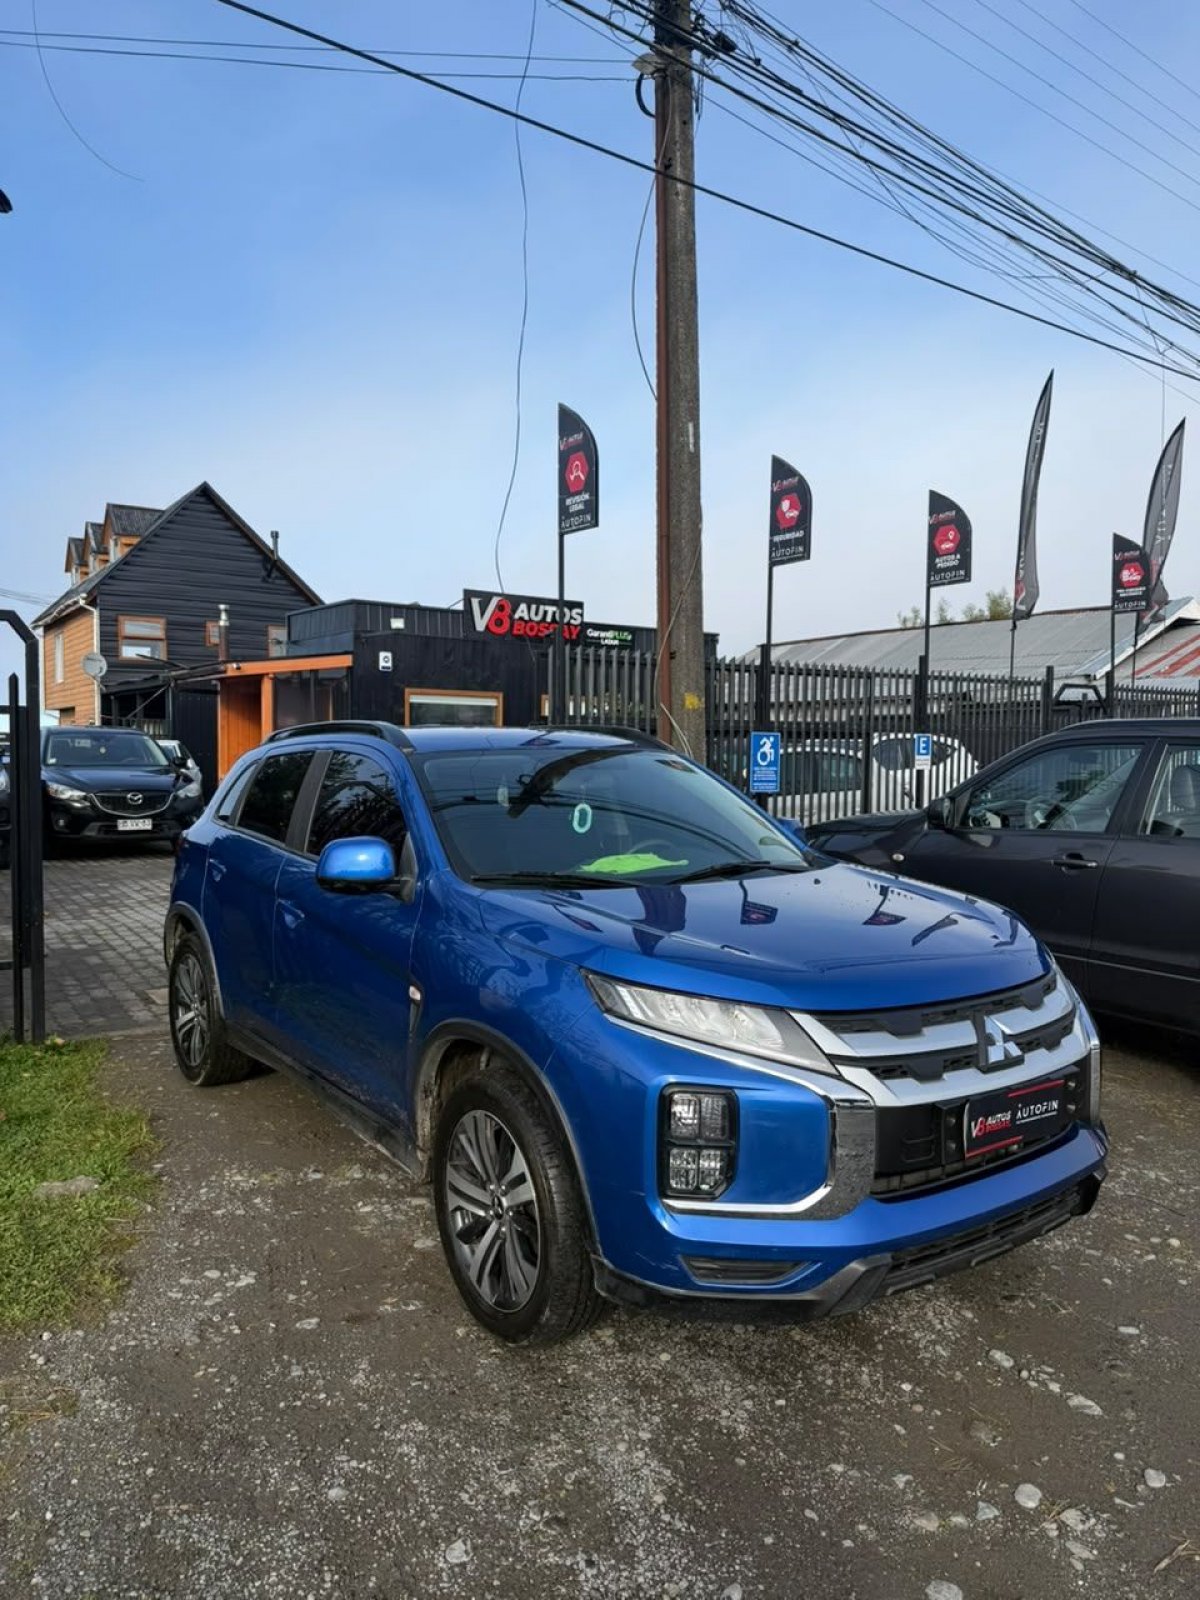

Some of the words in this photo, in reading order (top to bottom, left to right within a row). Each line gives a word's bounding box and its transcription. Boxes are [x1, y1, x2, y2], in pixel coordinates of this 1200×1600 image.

[470, 596, 511, 636] V8
[513, 602, 583, 626] AUTOS
[919, 737, 928, 754] E
[986, 1111, 1012, 1124] AUTOS
[1016, 1100, 1059, 1120] AUTOFIN
[971, 1116, 986, 1139] V8
